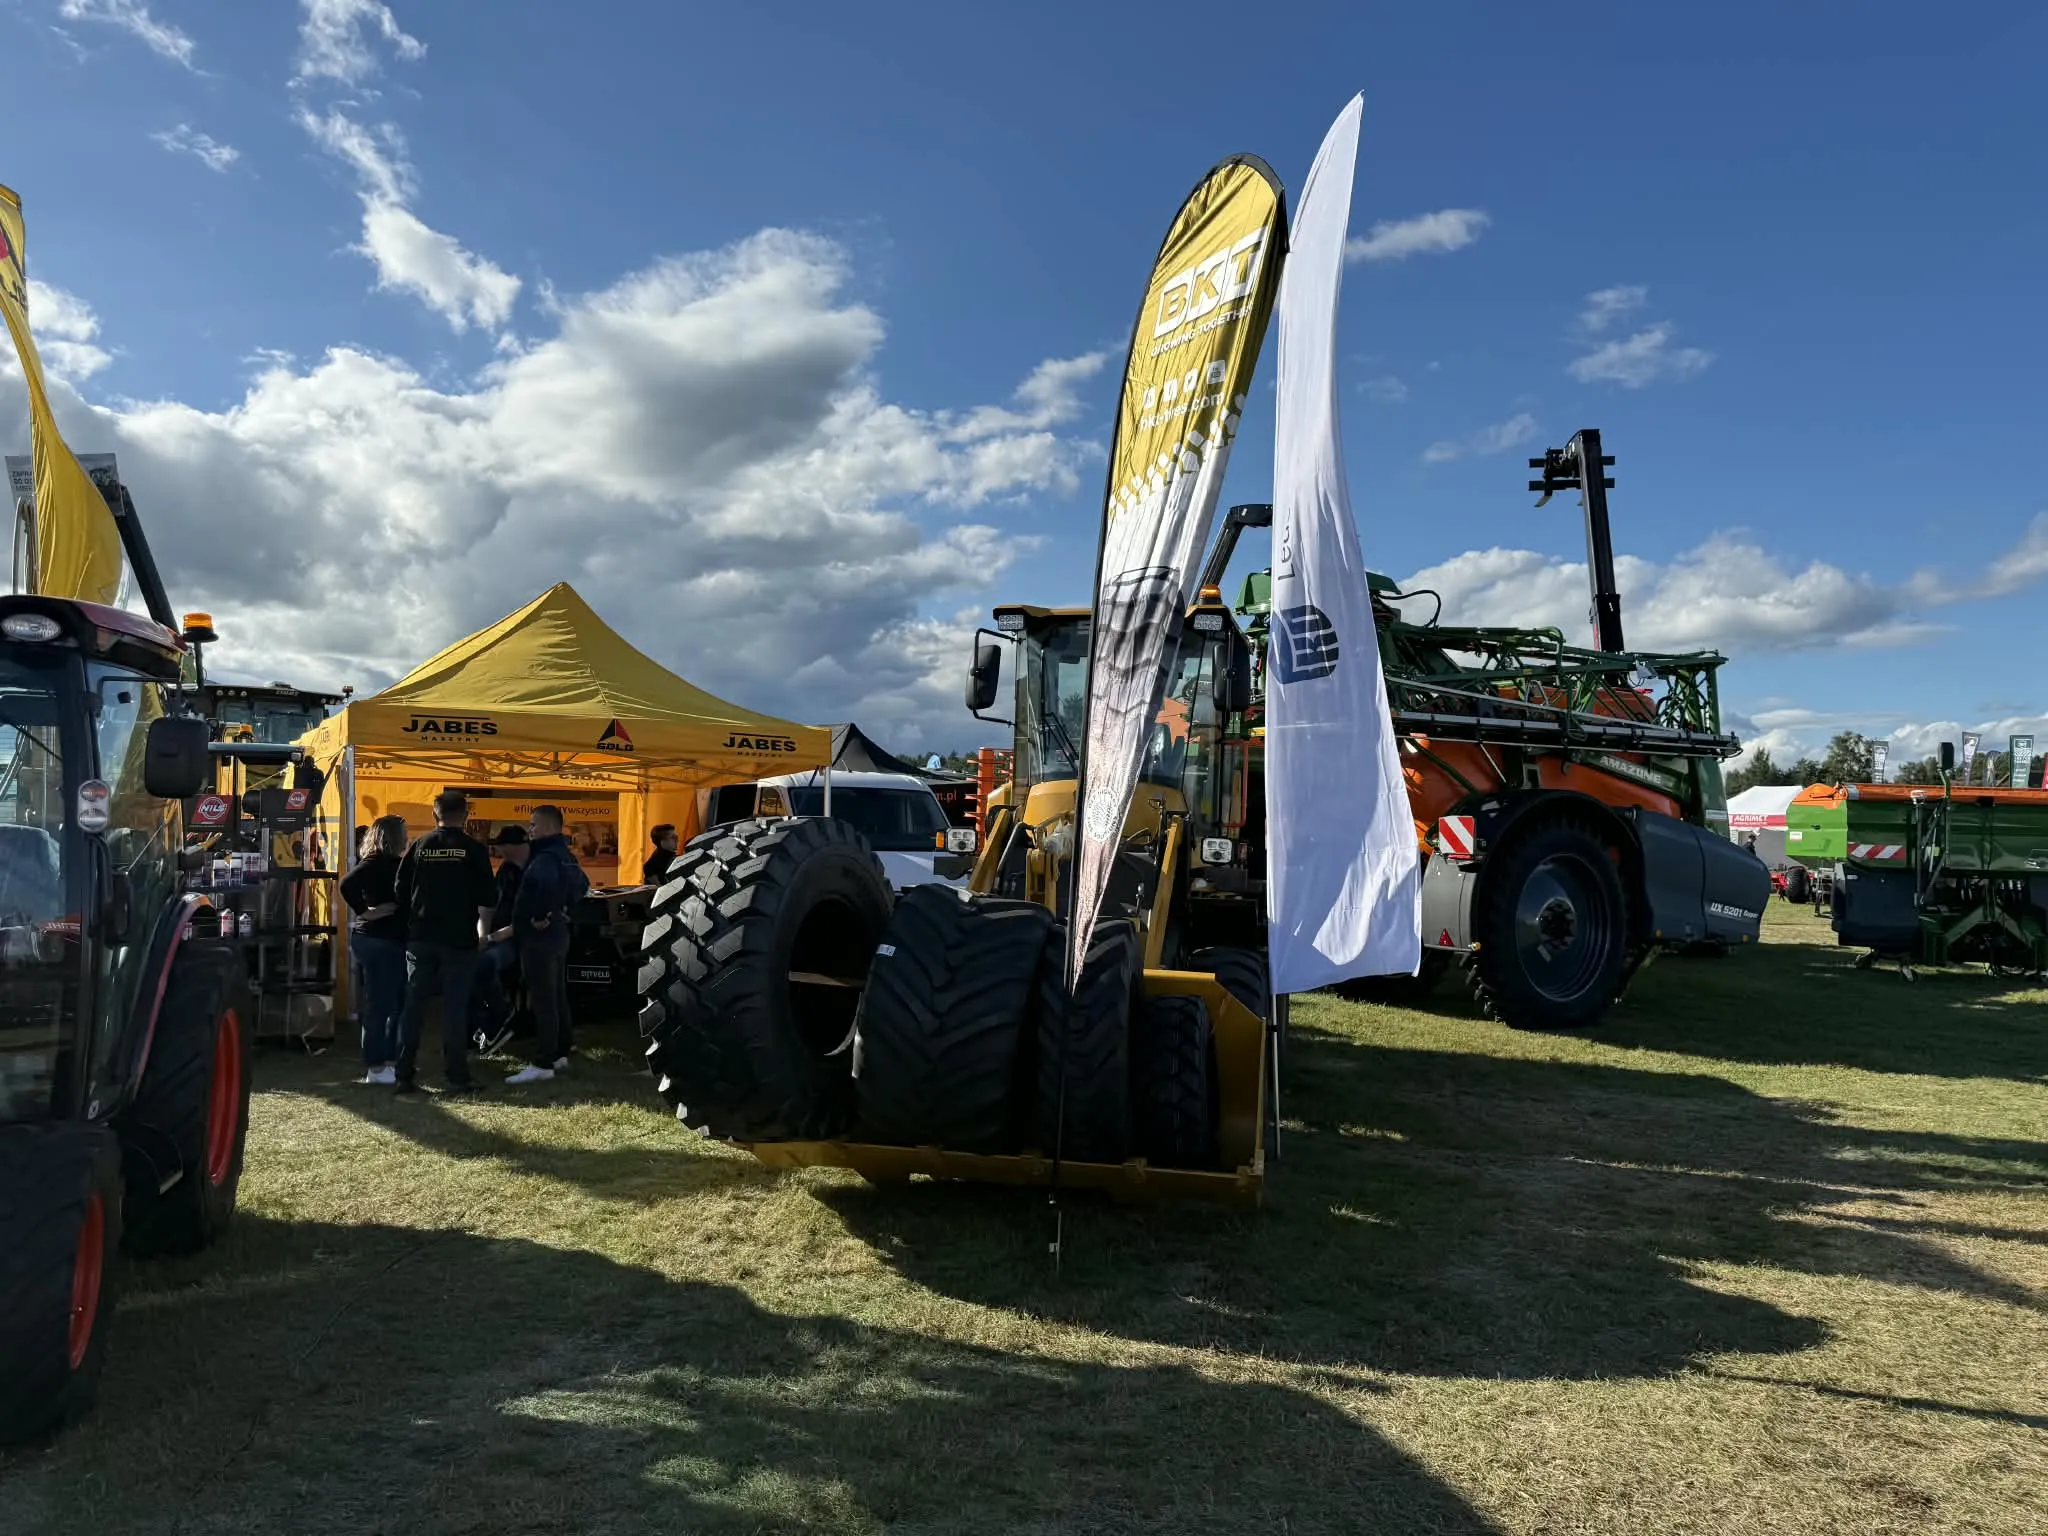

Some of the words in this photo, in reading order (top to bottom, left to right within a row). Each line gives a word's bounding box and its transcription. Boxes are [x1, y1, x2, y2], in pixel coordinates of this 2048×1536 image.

[1155, 231, 1266, 335] BKT
[1151, 330, 1196, 358] GROWING
[1141, 391, 1226, 430] bkt-tires.com
[401, 718, 498, 736] JABES
[421, 735, 480, 743] MASZYNY
[722, 736, 797, 752] JABES
[1600, 755, 1662, 784] AMAZONE
[199, 803, 228, 812] NILS
[1710, 902, 1723, 913] UX
[1723, 905, 1743, 918] 5201
